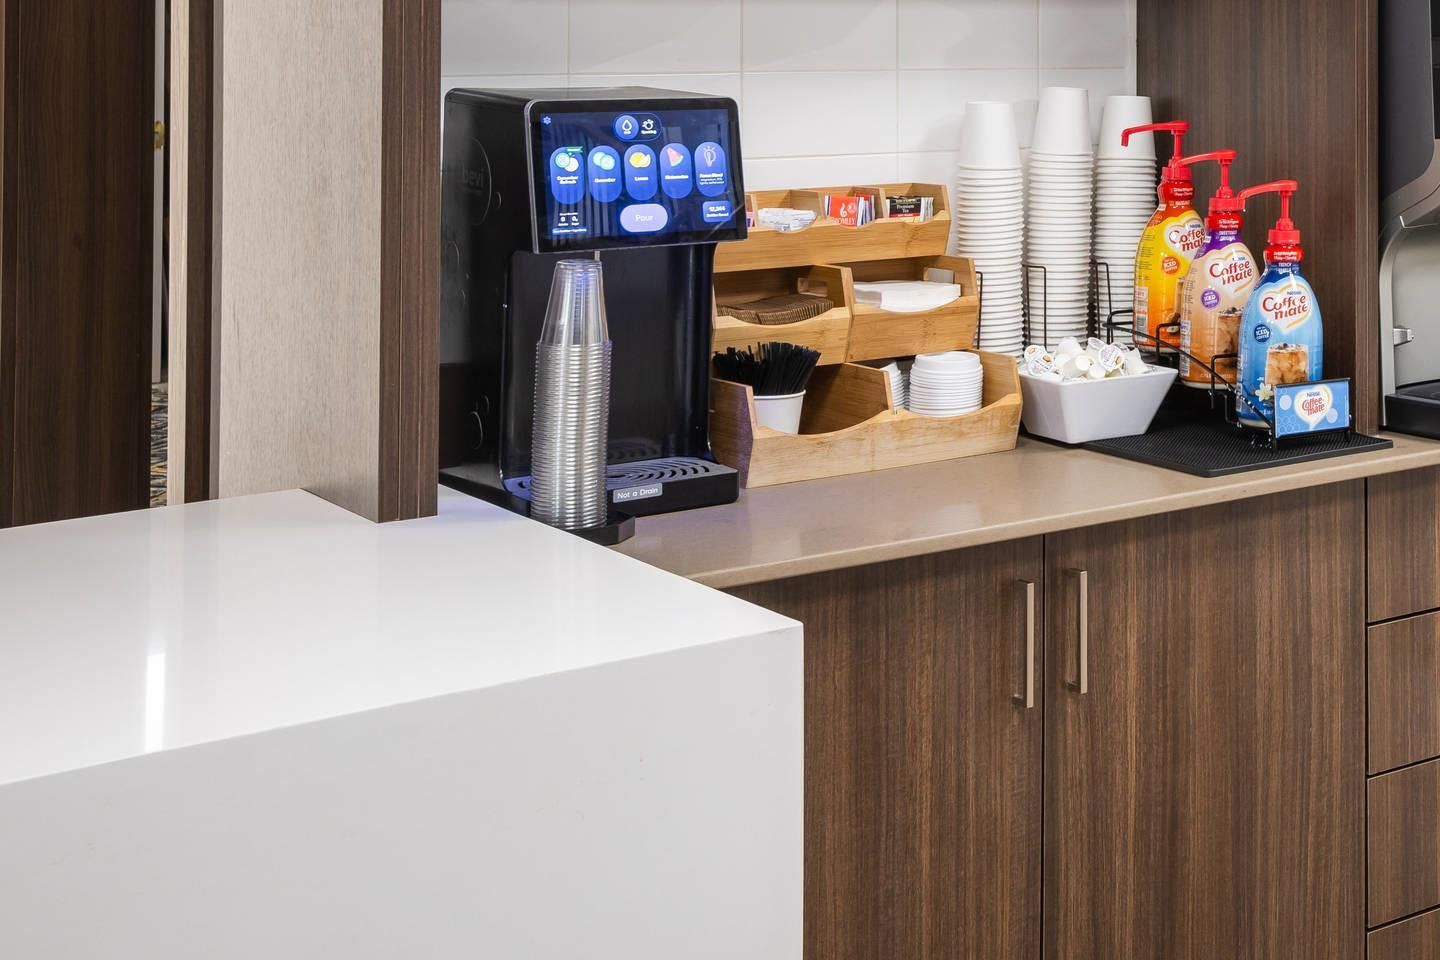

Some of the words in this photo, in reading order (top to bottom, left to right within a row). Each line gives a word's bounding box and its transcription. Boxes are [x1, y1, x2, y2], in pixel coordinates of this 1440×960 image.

[635, 214, 654, 222] Pour
[1168, 228, 1205, 244] Coffee
[1182, 236, 1205, 252] mat
[1209, 260, 1250, 278] Coffee
[1222, 267, 1253, 285] mate
[1262, 295, 1306, 312] Coffee
[1274, 303, 1308, 320] mate
[617, 491, 630, 500] Not
[639, 488, 659, 496] Drain
